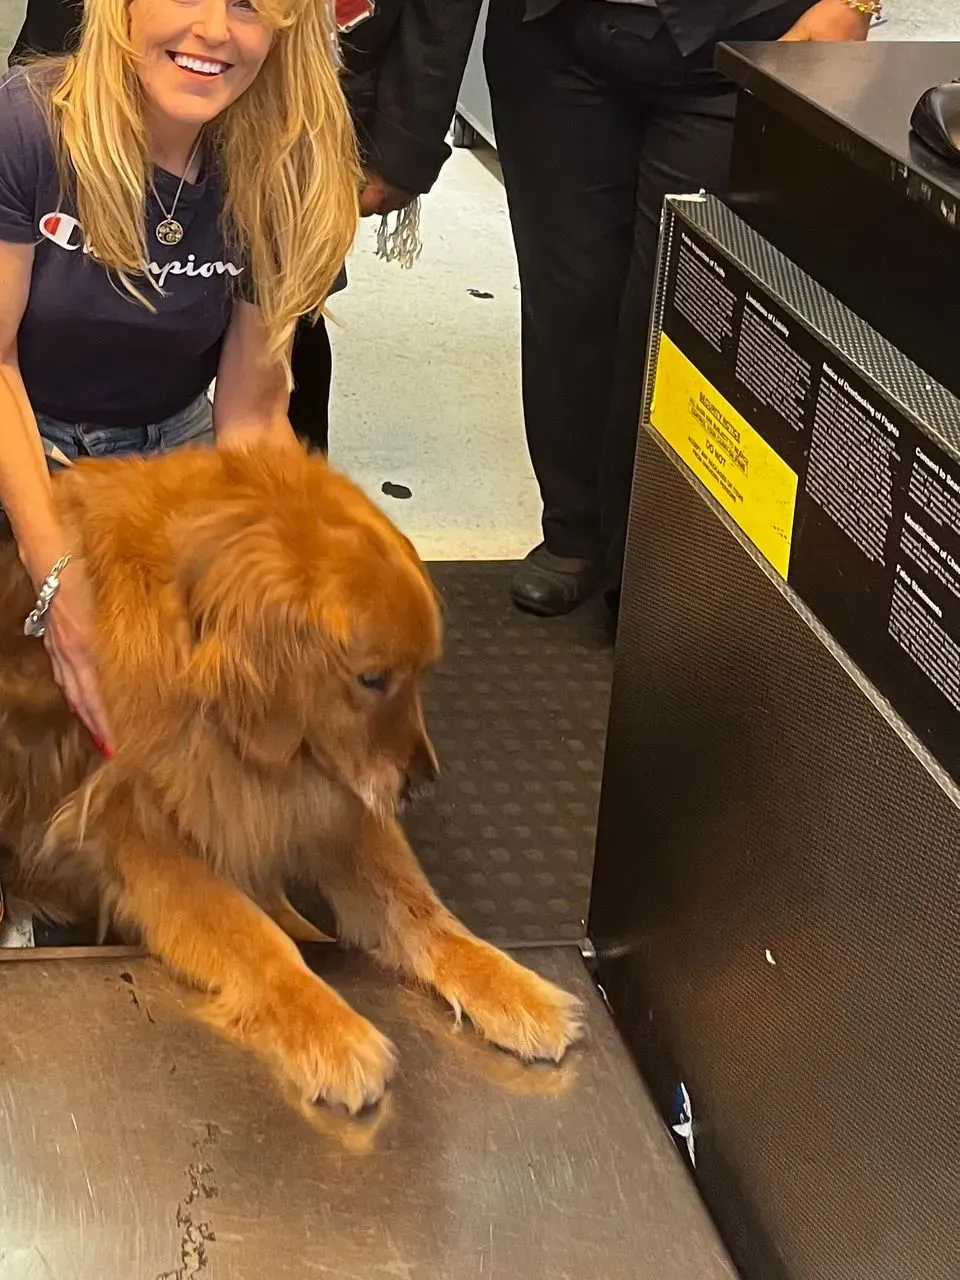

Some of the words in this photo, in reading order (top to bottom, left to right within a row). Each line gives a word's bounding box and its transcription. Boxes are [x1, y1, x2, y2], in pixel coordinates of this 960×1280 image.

[822, 361, 838, 381] Notice
[838, 377, 844, 386] of
[843, 381, 875, 417] Overbooking
[875, 411, 881, 421] of
[881, 415, 900, 438] Flights
[705, 439, 714, 454] DO
[714, 449, 726, 467] NOT
[915, 446, 939, 474] Consent
[939, 468, 946, 480] to
[904, 512, 940, 554] Identification
[940, 549, 947, 560] of
[896, 564, 911, 586] False
[911, 579, 943, 618] Statements
